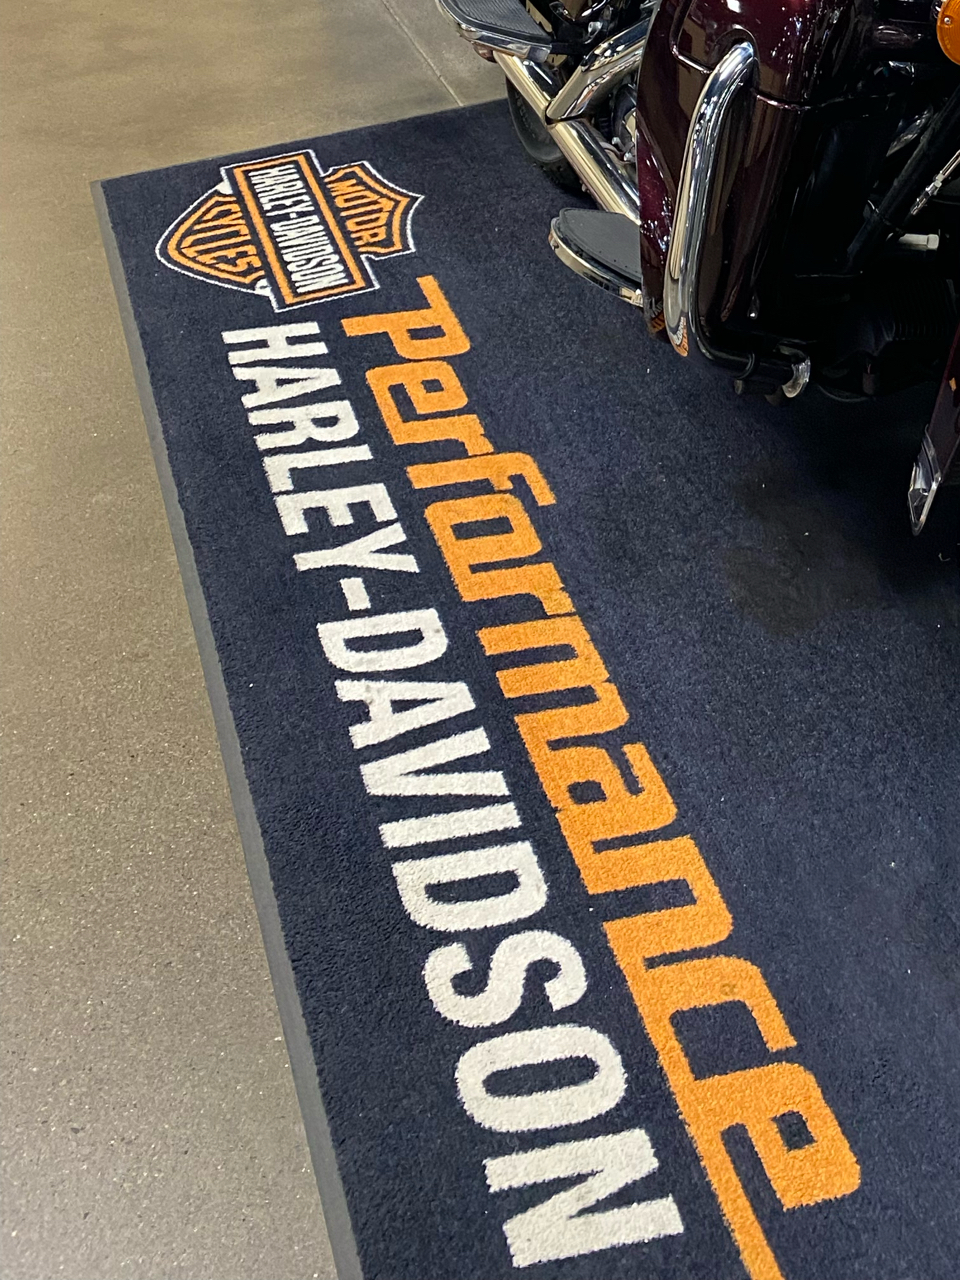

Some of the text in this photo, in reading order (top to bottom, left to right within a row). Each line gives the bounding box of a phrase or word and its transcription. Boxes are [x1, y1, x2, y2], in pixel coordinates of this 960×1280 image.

[180, 198, 264, 274] CYCLES
[248, 163, 350, 294] HARLEY-DAVIDSON
[327, 177, 396, 247] MOTOR
[220, 321, 685, 1269] HARLEY-DAVIDSON
[340, 274, 862, 1210] Performance
